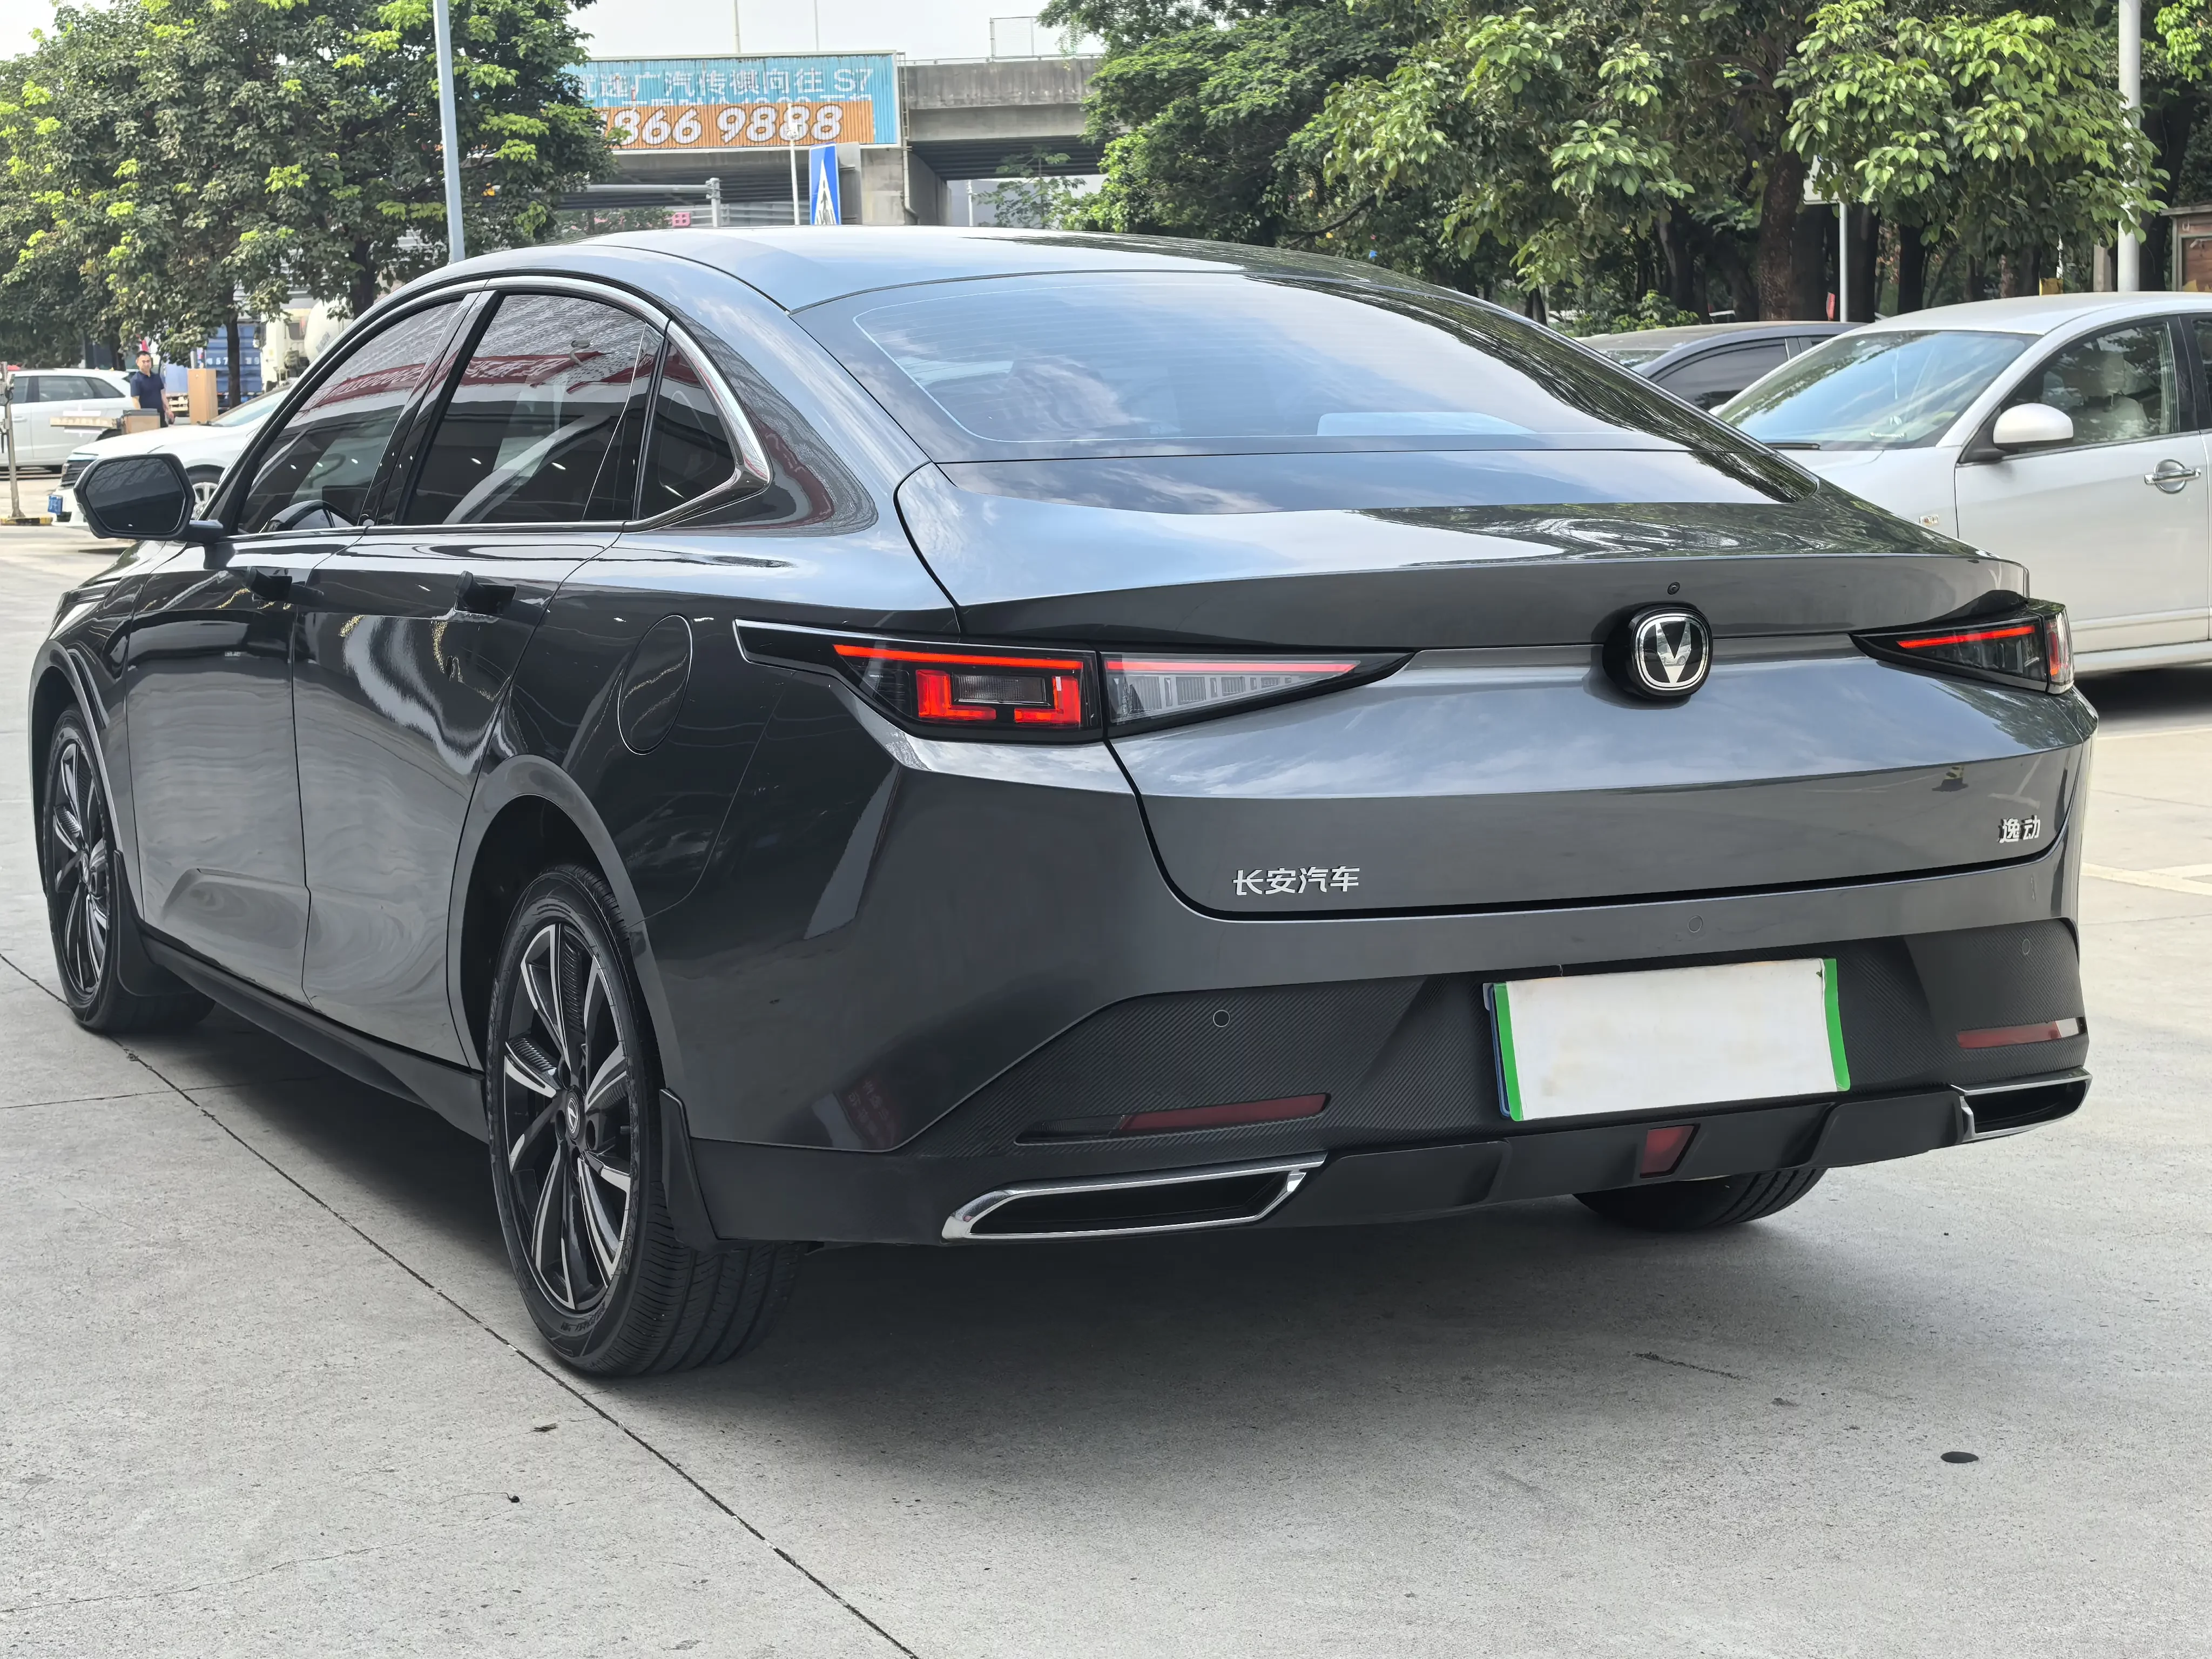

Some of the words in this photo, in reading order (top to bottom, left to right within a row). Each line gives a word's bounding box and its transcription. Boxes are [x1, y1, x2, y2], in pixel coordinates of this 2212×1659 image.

[834, 68, 873, 92] S7
[717, 104, 844, 145] 9888
[1999, 814, 2041, 844] 逸动
[1232, 866, 1360, 895] 长安汽车
